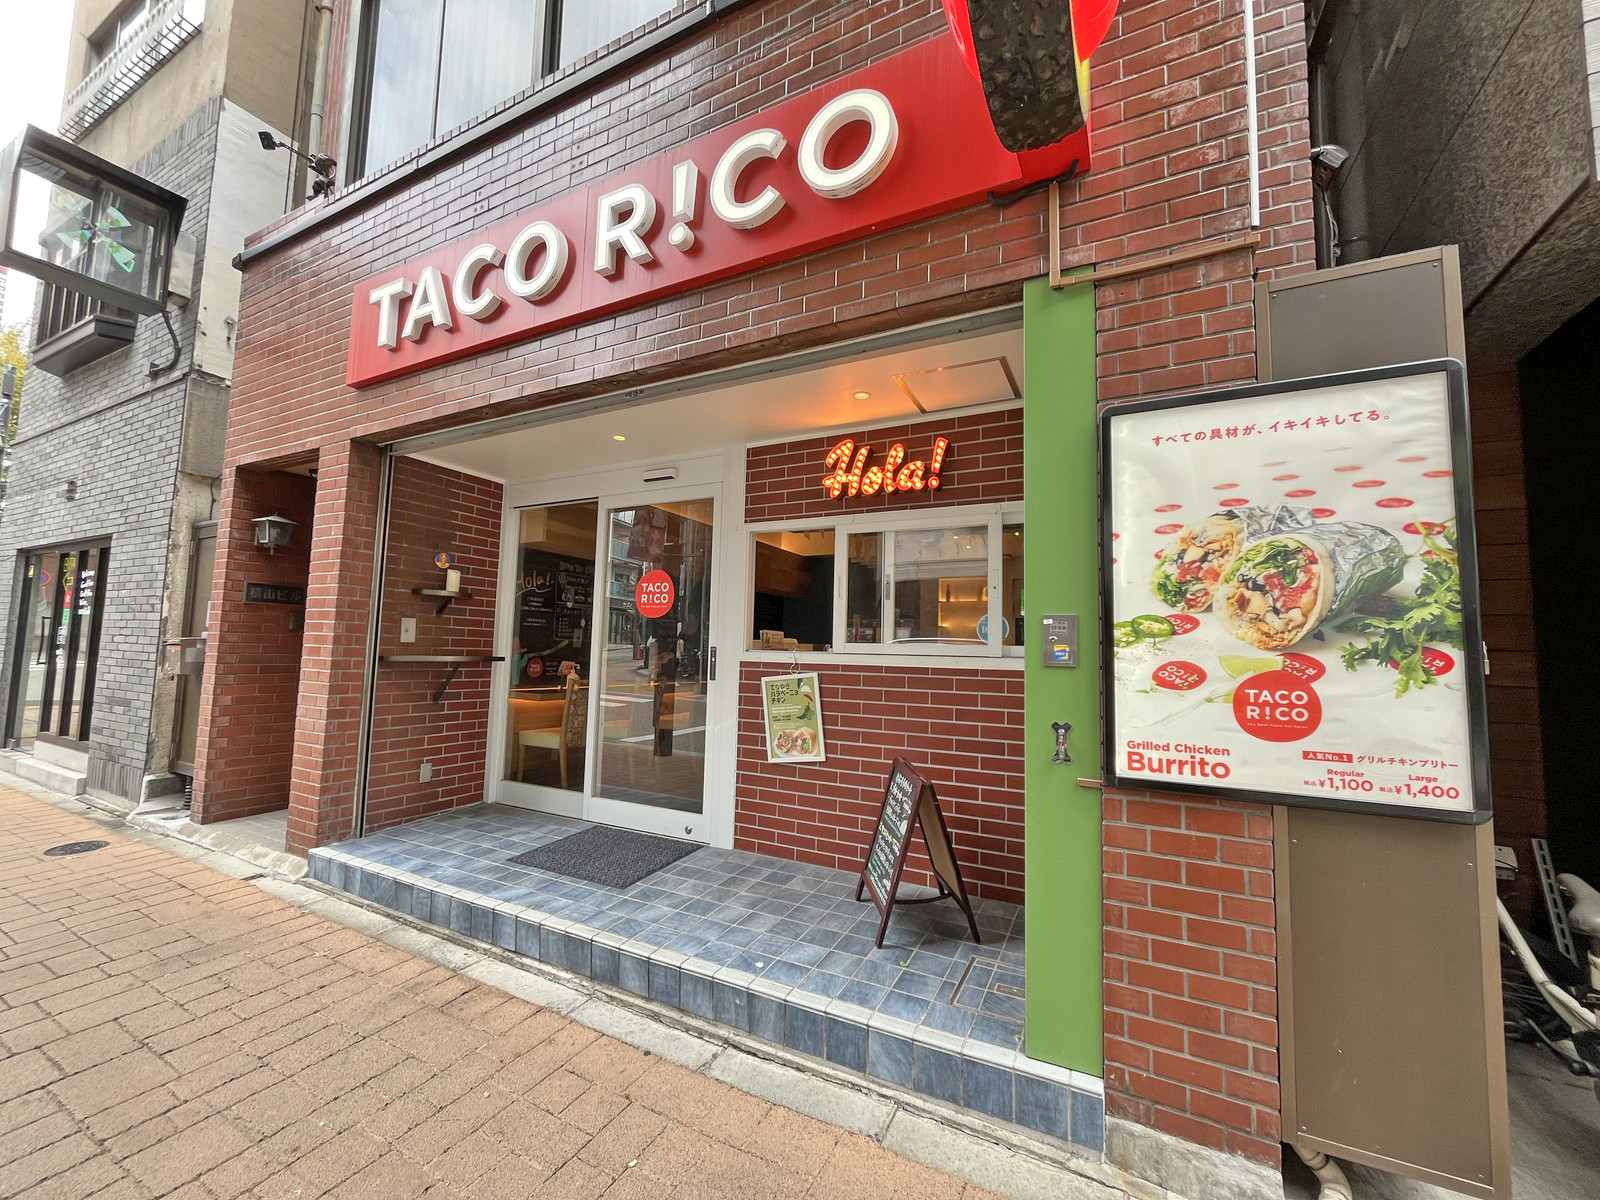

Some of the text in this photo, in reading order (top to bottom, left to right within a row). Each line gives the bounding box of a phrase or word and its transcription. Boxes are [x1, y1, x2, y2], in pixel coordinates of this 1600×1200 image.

[369, 89, 900, 350] TACO R!CO
[1152, 409, 1391, 447] すべての具材が、イキイキしてる。
[822, 436, 949, 498] Hola!
[642, 583, 670, 593] TACO
[641, 593, 669, 604] R!CO
[1244, 689, 1309, 705] TACO
[1246, 705, 1309, 722] R!CO
[1127, 740, 1231, 756] Grilled Chicken
[1127, 751, 1231, 779] Burrito
[1307, 752, 1459, 769] 人気No.1 グリルチキンブリトー
[1327, 768, 1365, 778] Regular
[1408, 774, 1438, 783] Large
